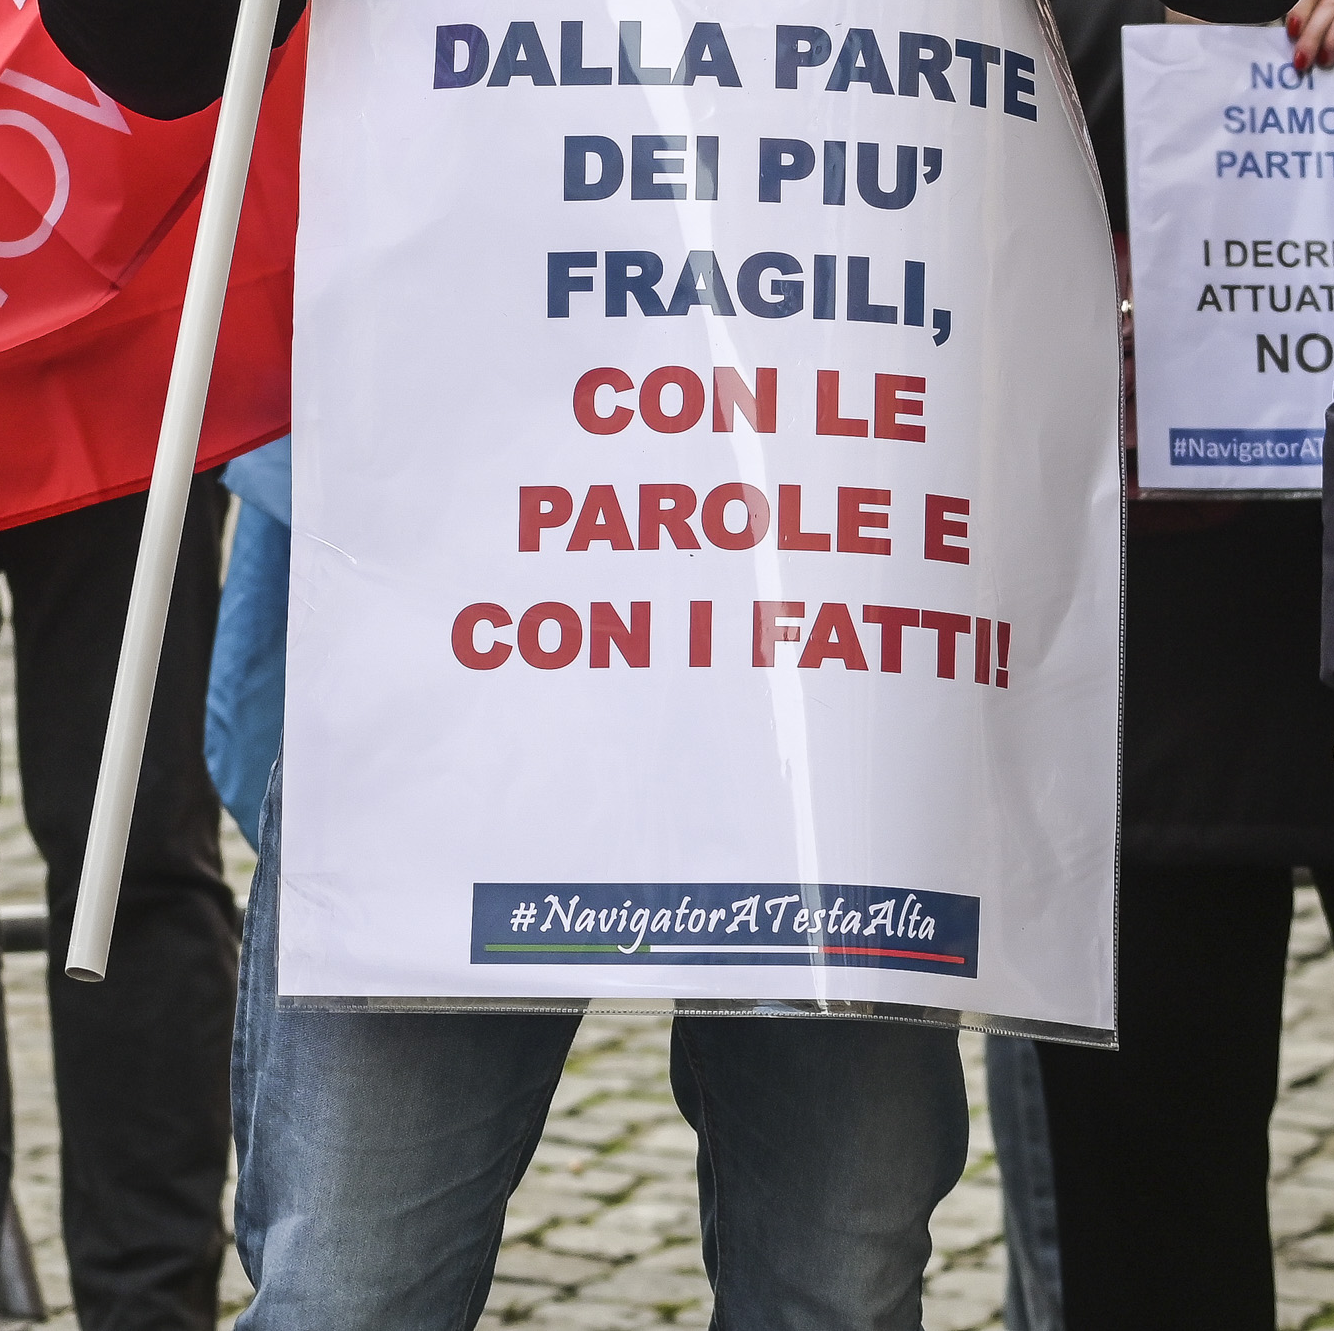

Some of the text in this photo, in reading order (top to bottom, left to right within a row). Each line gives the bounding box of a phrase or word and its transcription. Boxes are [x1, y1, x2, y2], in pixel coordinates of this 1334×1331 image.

[433, 21, 1039, 123] DALLA PARTE
[563, 134, 719, 202] DEI
[1203, 239, 1210, 267] I
[546, 249, 953, 348] FRAGILI,
[1256, 332, 1334, 374] NO
[572, 366, 927, 444] CON LE
[518, 483, 970, 566] PAROLE E
[450, 600, 1012, 690] CON I FATTI!
[510, 892, 936, 956] #NavigatorATestaAlta
